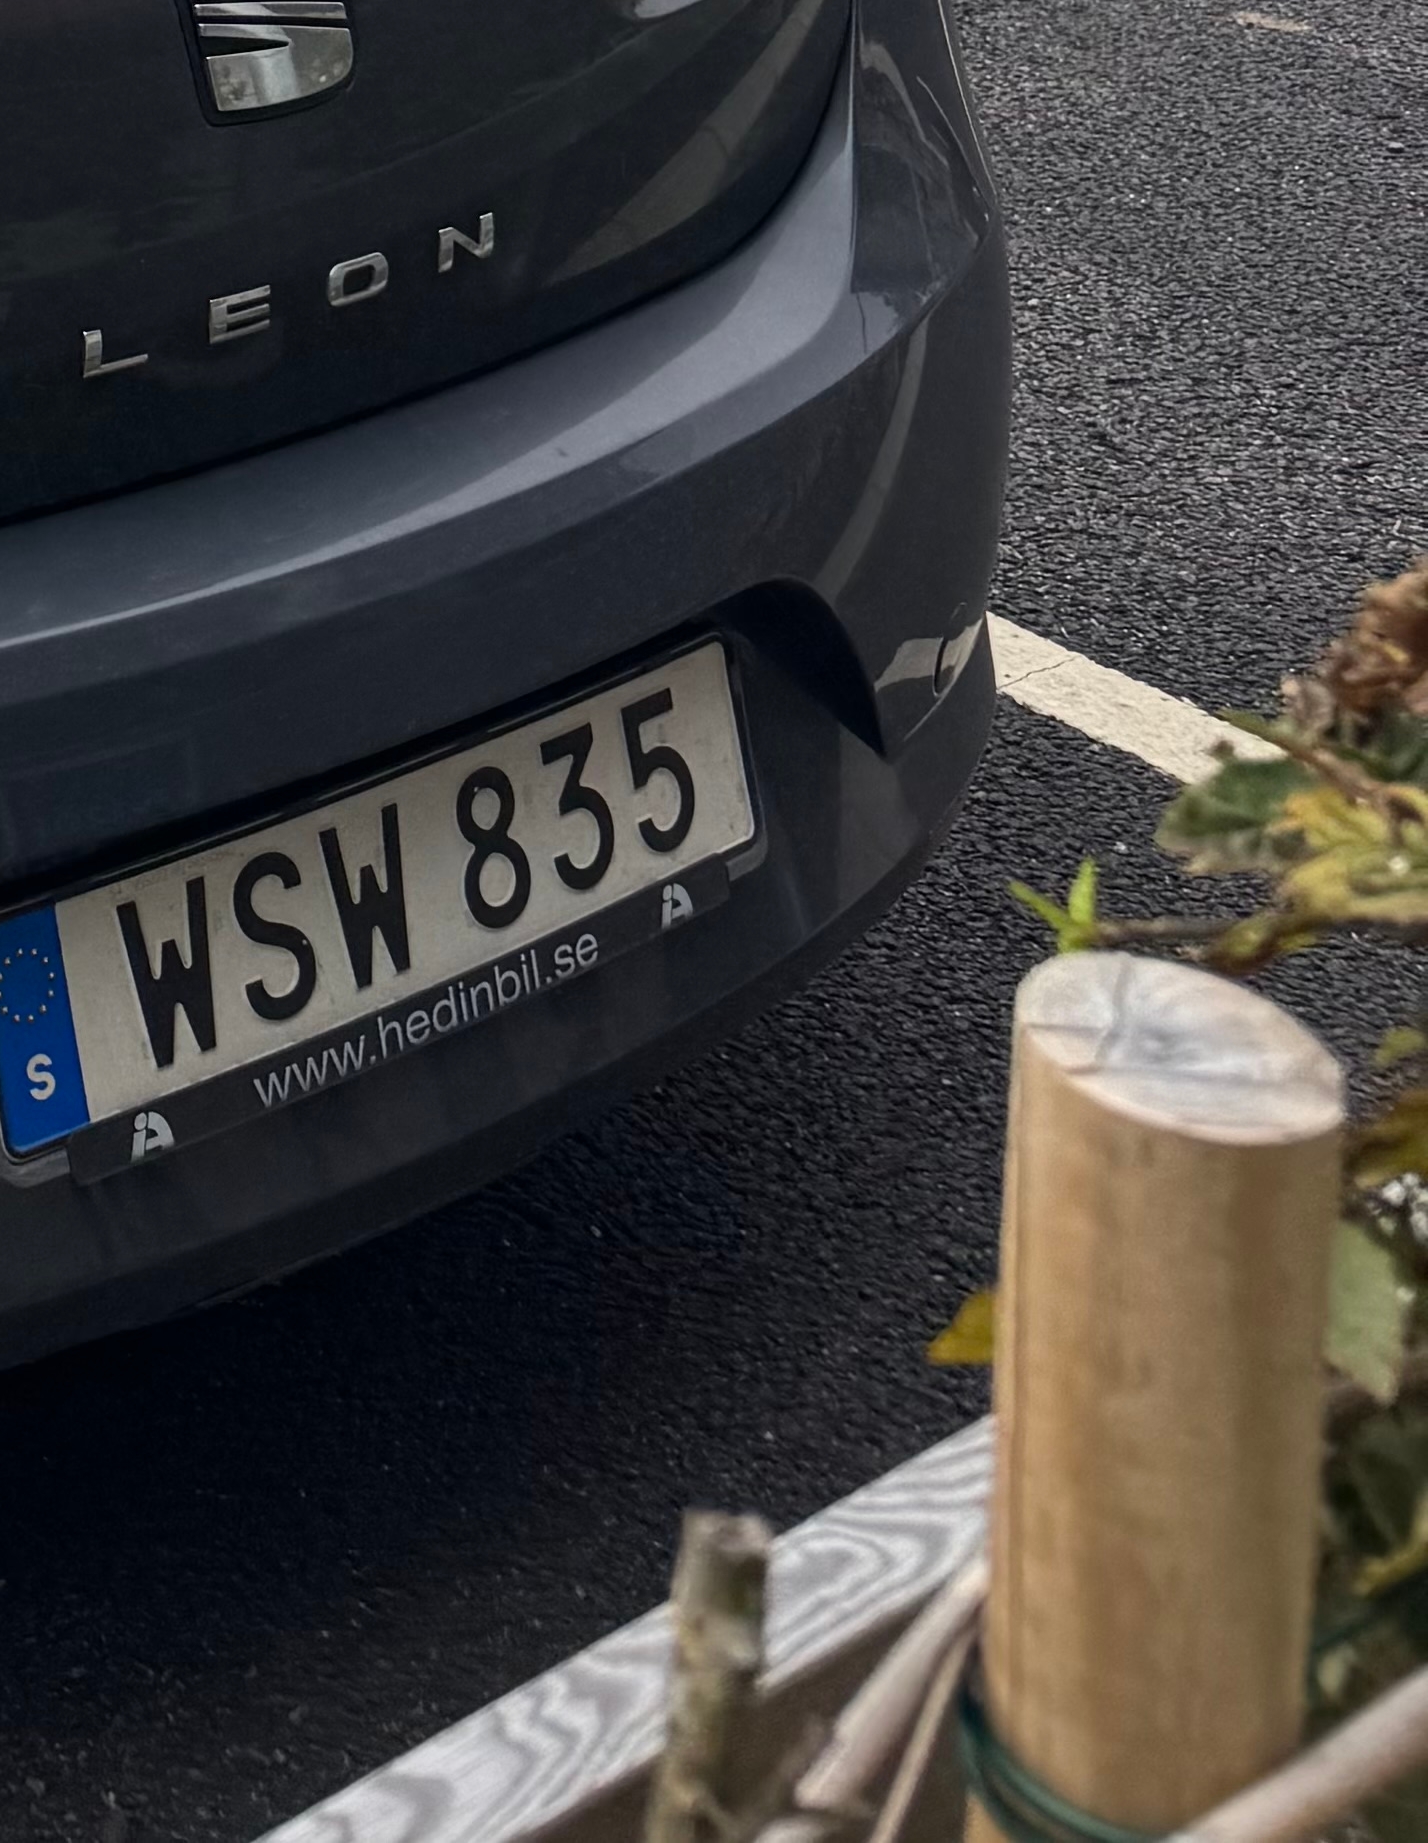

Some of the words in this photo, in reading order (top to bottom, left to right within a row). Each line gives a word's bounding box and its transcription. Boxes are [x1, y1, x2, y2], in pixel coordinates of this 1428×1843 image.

[83, 212, 494, 378] LEON
[26, 1052, 57, 1101] S
[252, 932, 599, 1108] www.hedinbil.se
